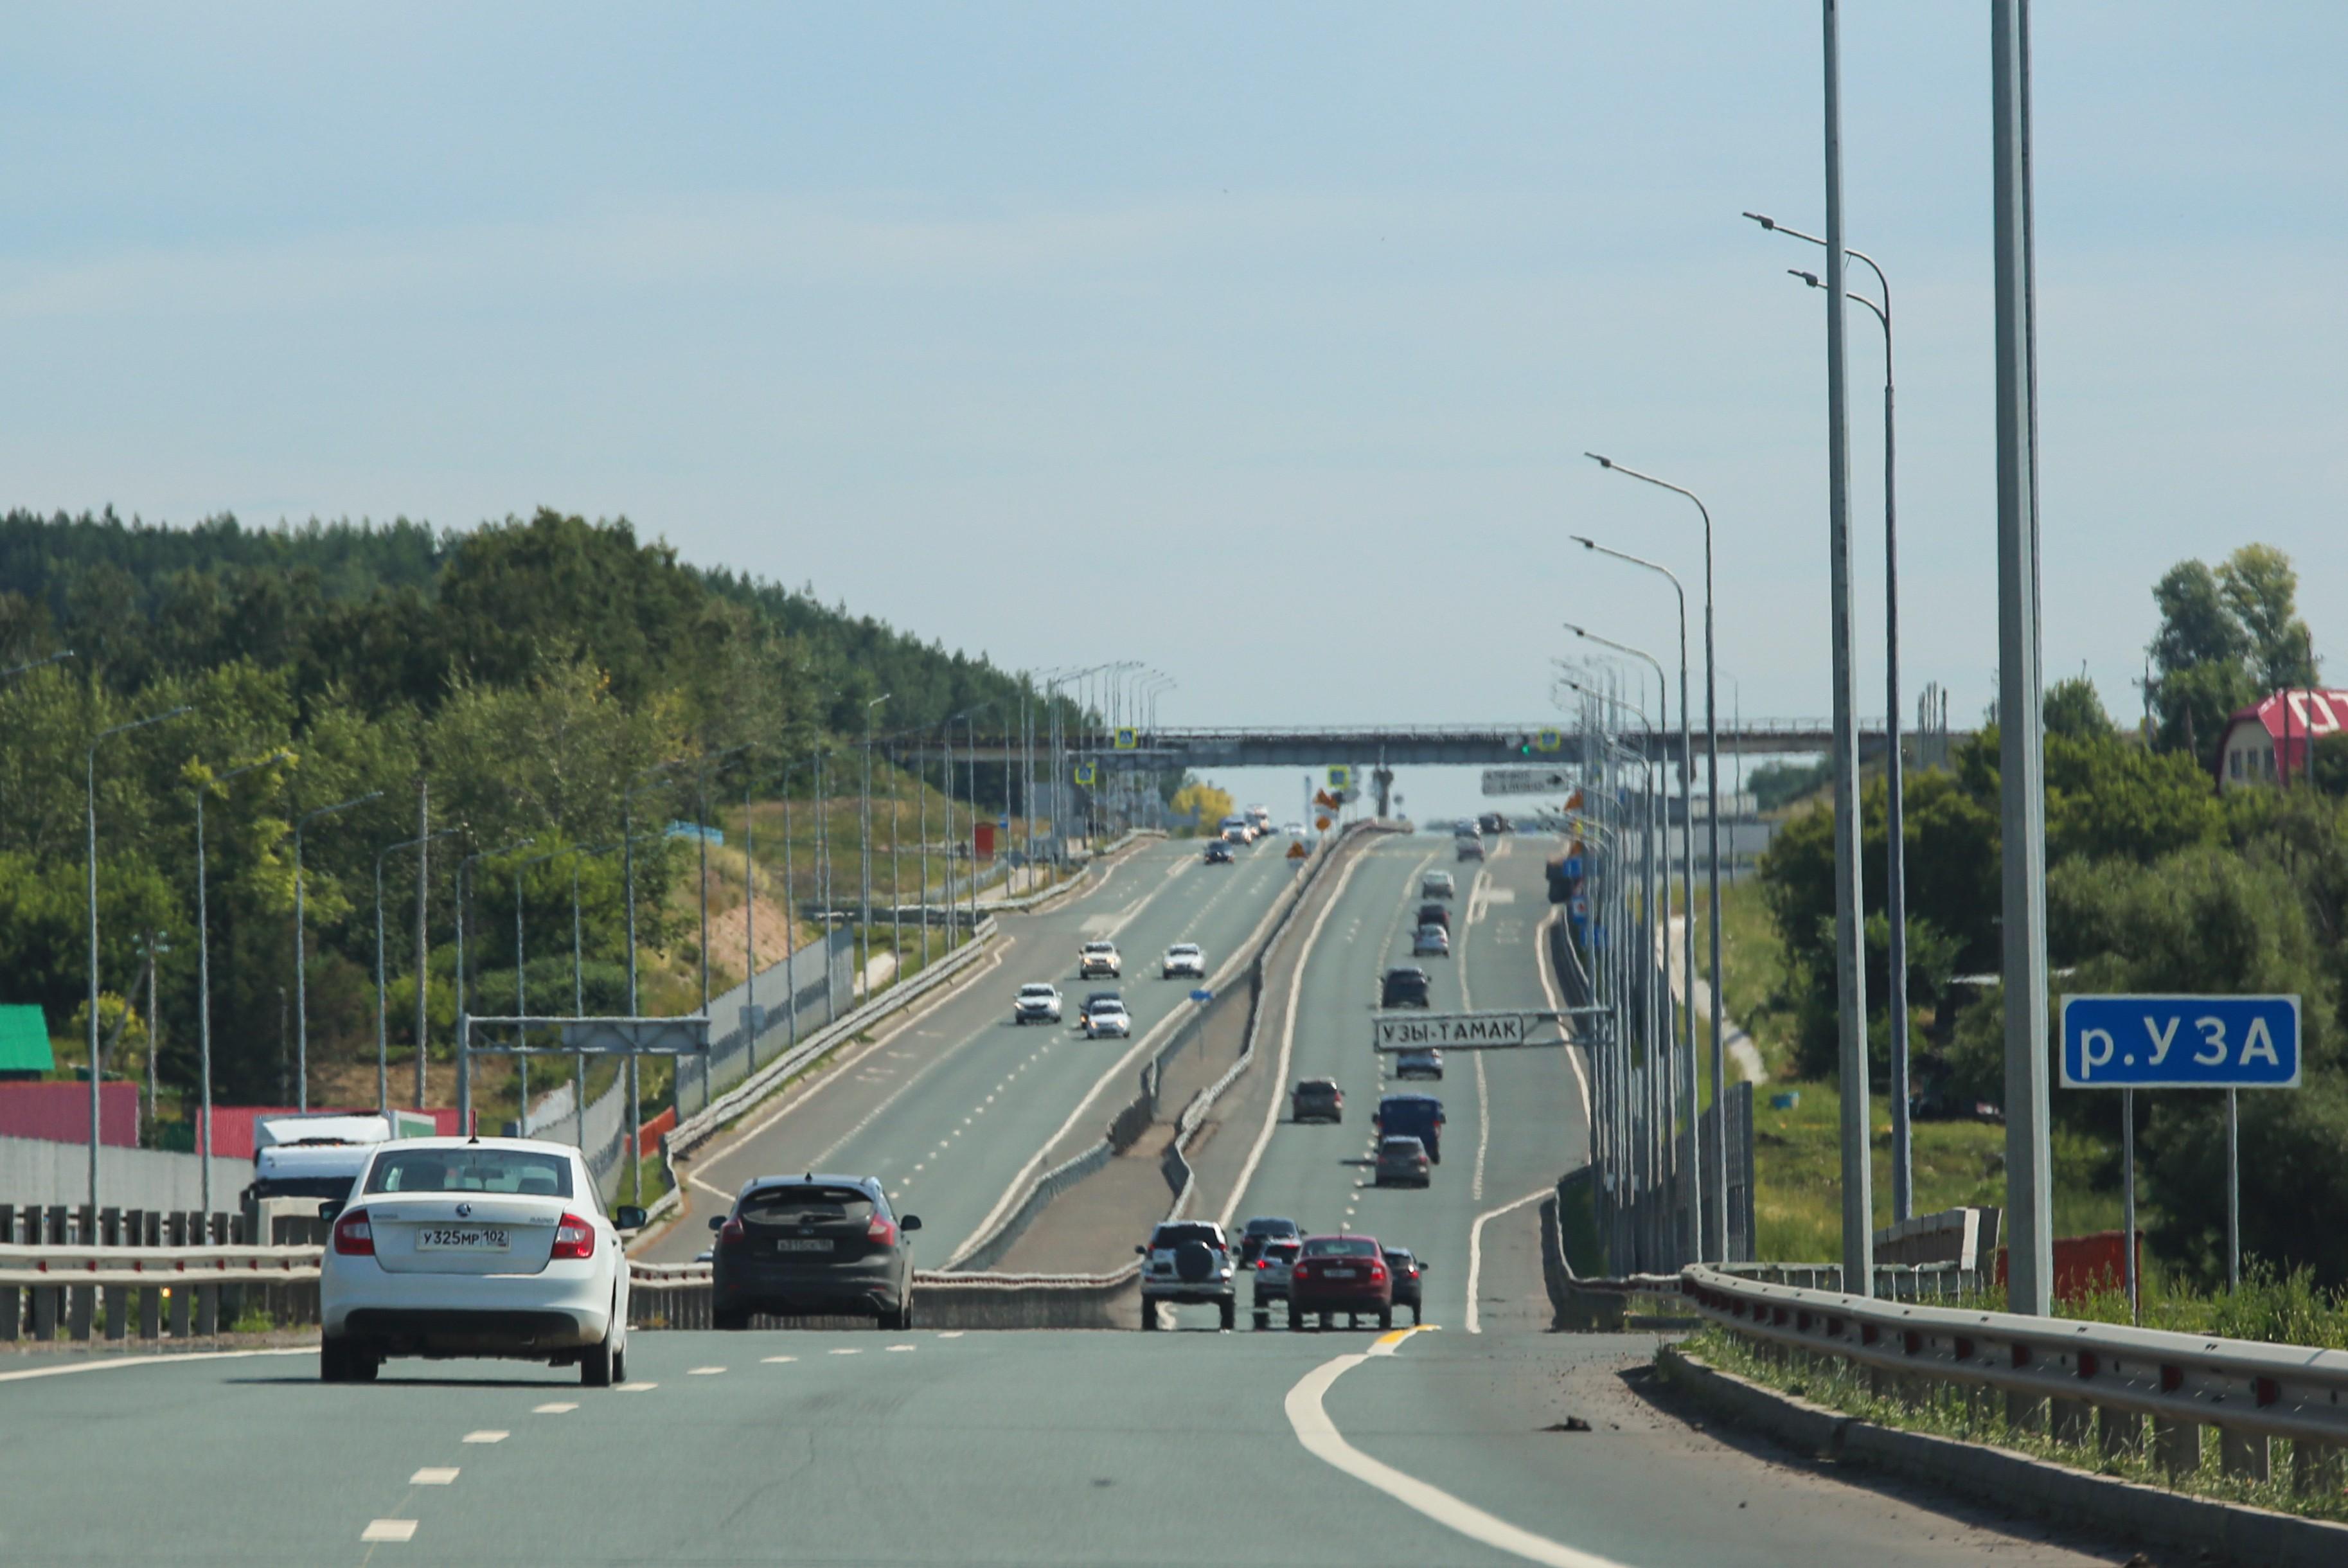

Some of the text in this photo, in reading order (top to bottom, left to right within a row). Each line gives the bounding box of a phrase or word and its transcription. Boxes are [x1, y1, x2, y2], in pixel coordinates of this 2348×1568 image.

[1383, 1020, 1516, 1042] УЗЫ-ТАМАК
[2081, 1016, 2279, 1080] р.УЗА
[483, 1230, 504, 1242] 102
